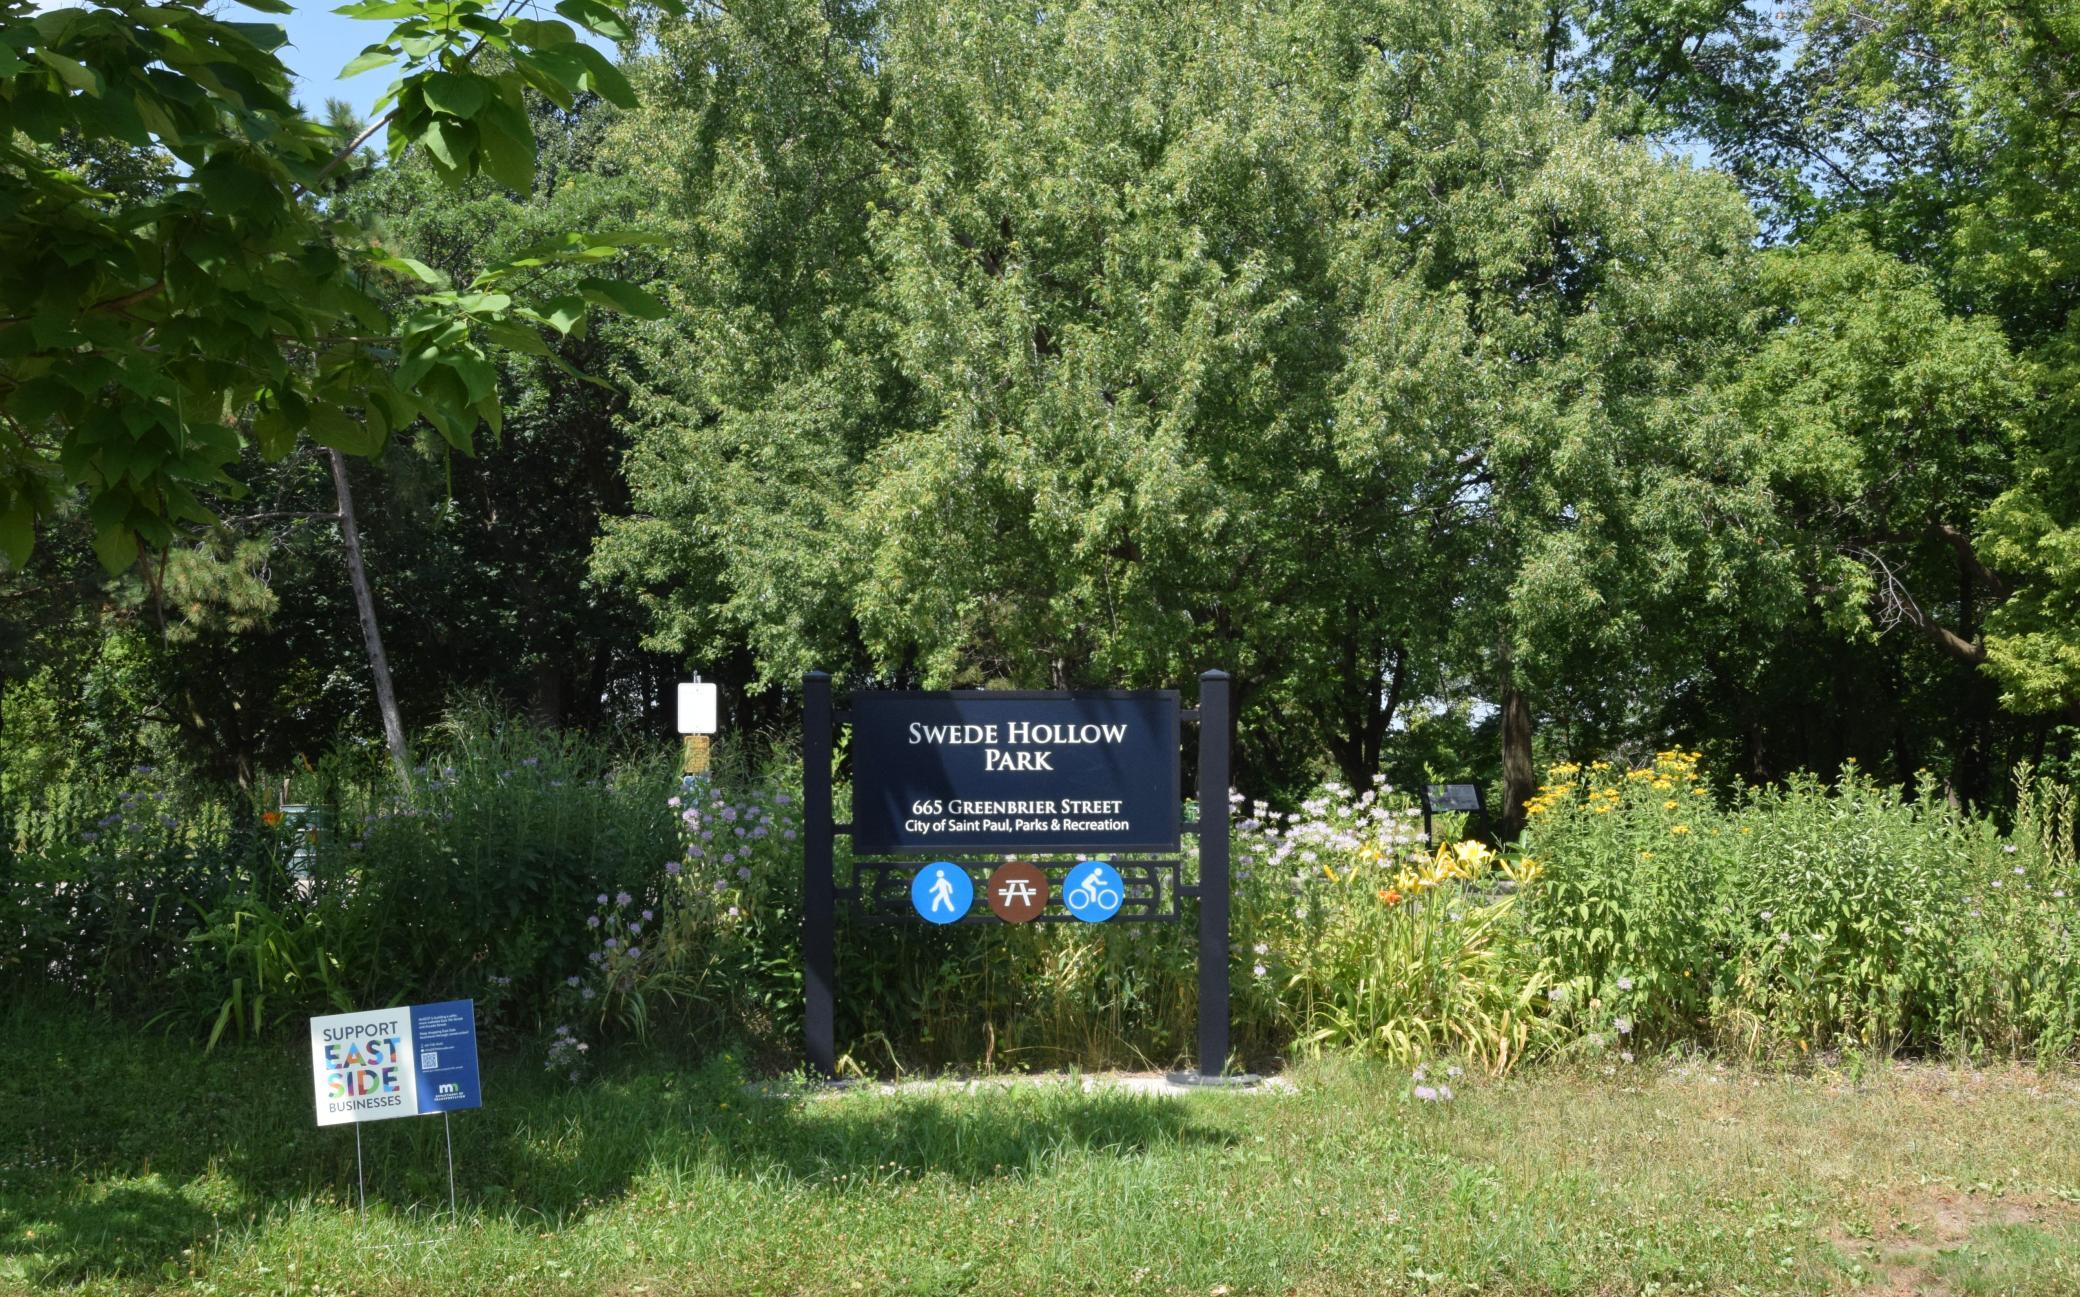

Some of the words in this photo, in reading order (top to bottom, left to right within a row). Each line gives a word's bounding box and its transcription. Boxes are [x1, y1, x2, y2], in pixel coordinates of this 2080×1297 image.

[908, 722, 998, 744] SWEDE
[1007, 721, 1128, 744] HOLLOW
[984, 748, 1054, 771] PARK
[912, 799, 943, 815] 665
[948, 798, 1058, 815] GREENBRIER
[1061, 798, 1123, 815] STREET
[905, 818, 931, 835] City
[932, 818, 947, 832] of
[948, 818, 981, 832] Saint
[983, 818, 1013, 834] Paul,
[1015, 818, 1049, 832] Parks
[1050, 819, 1061, 832] &
[1063, 818, 1130, 832] Recreation
[323, 1021, 398, 1042] SUPPORT
[324, 1037, 401, 1071] EAST
[327, 1066, 400, 1100] SIDE
[329, 1095, 402, 1113] BUSINESSES
